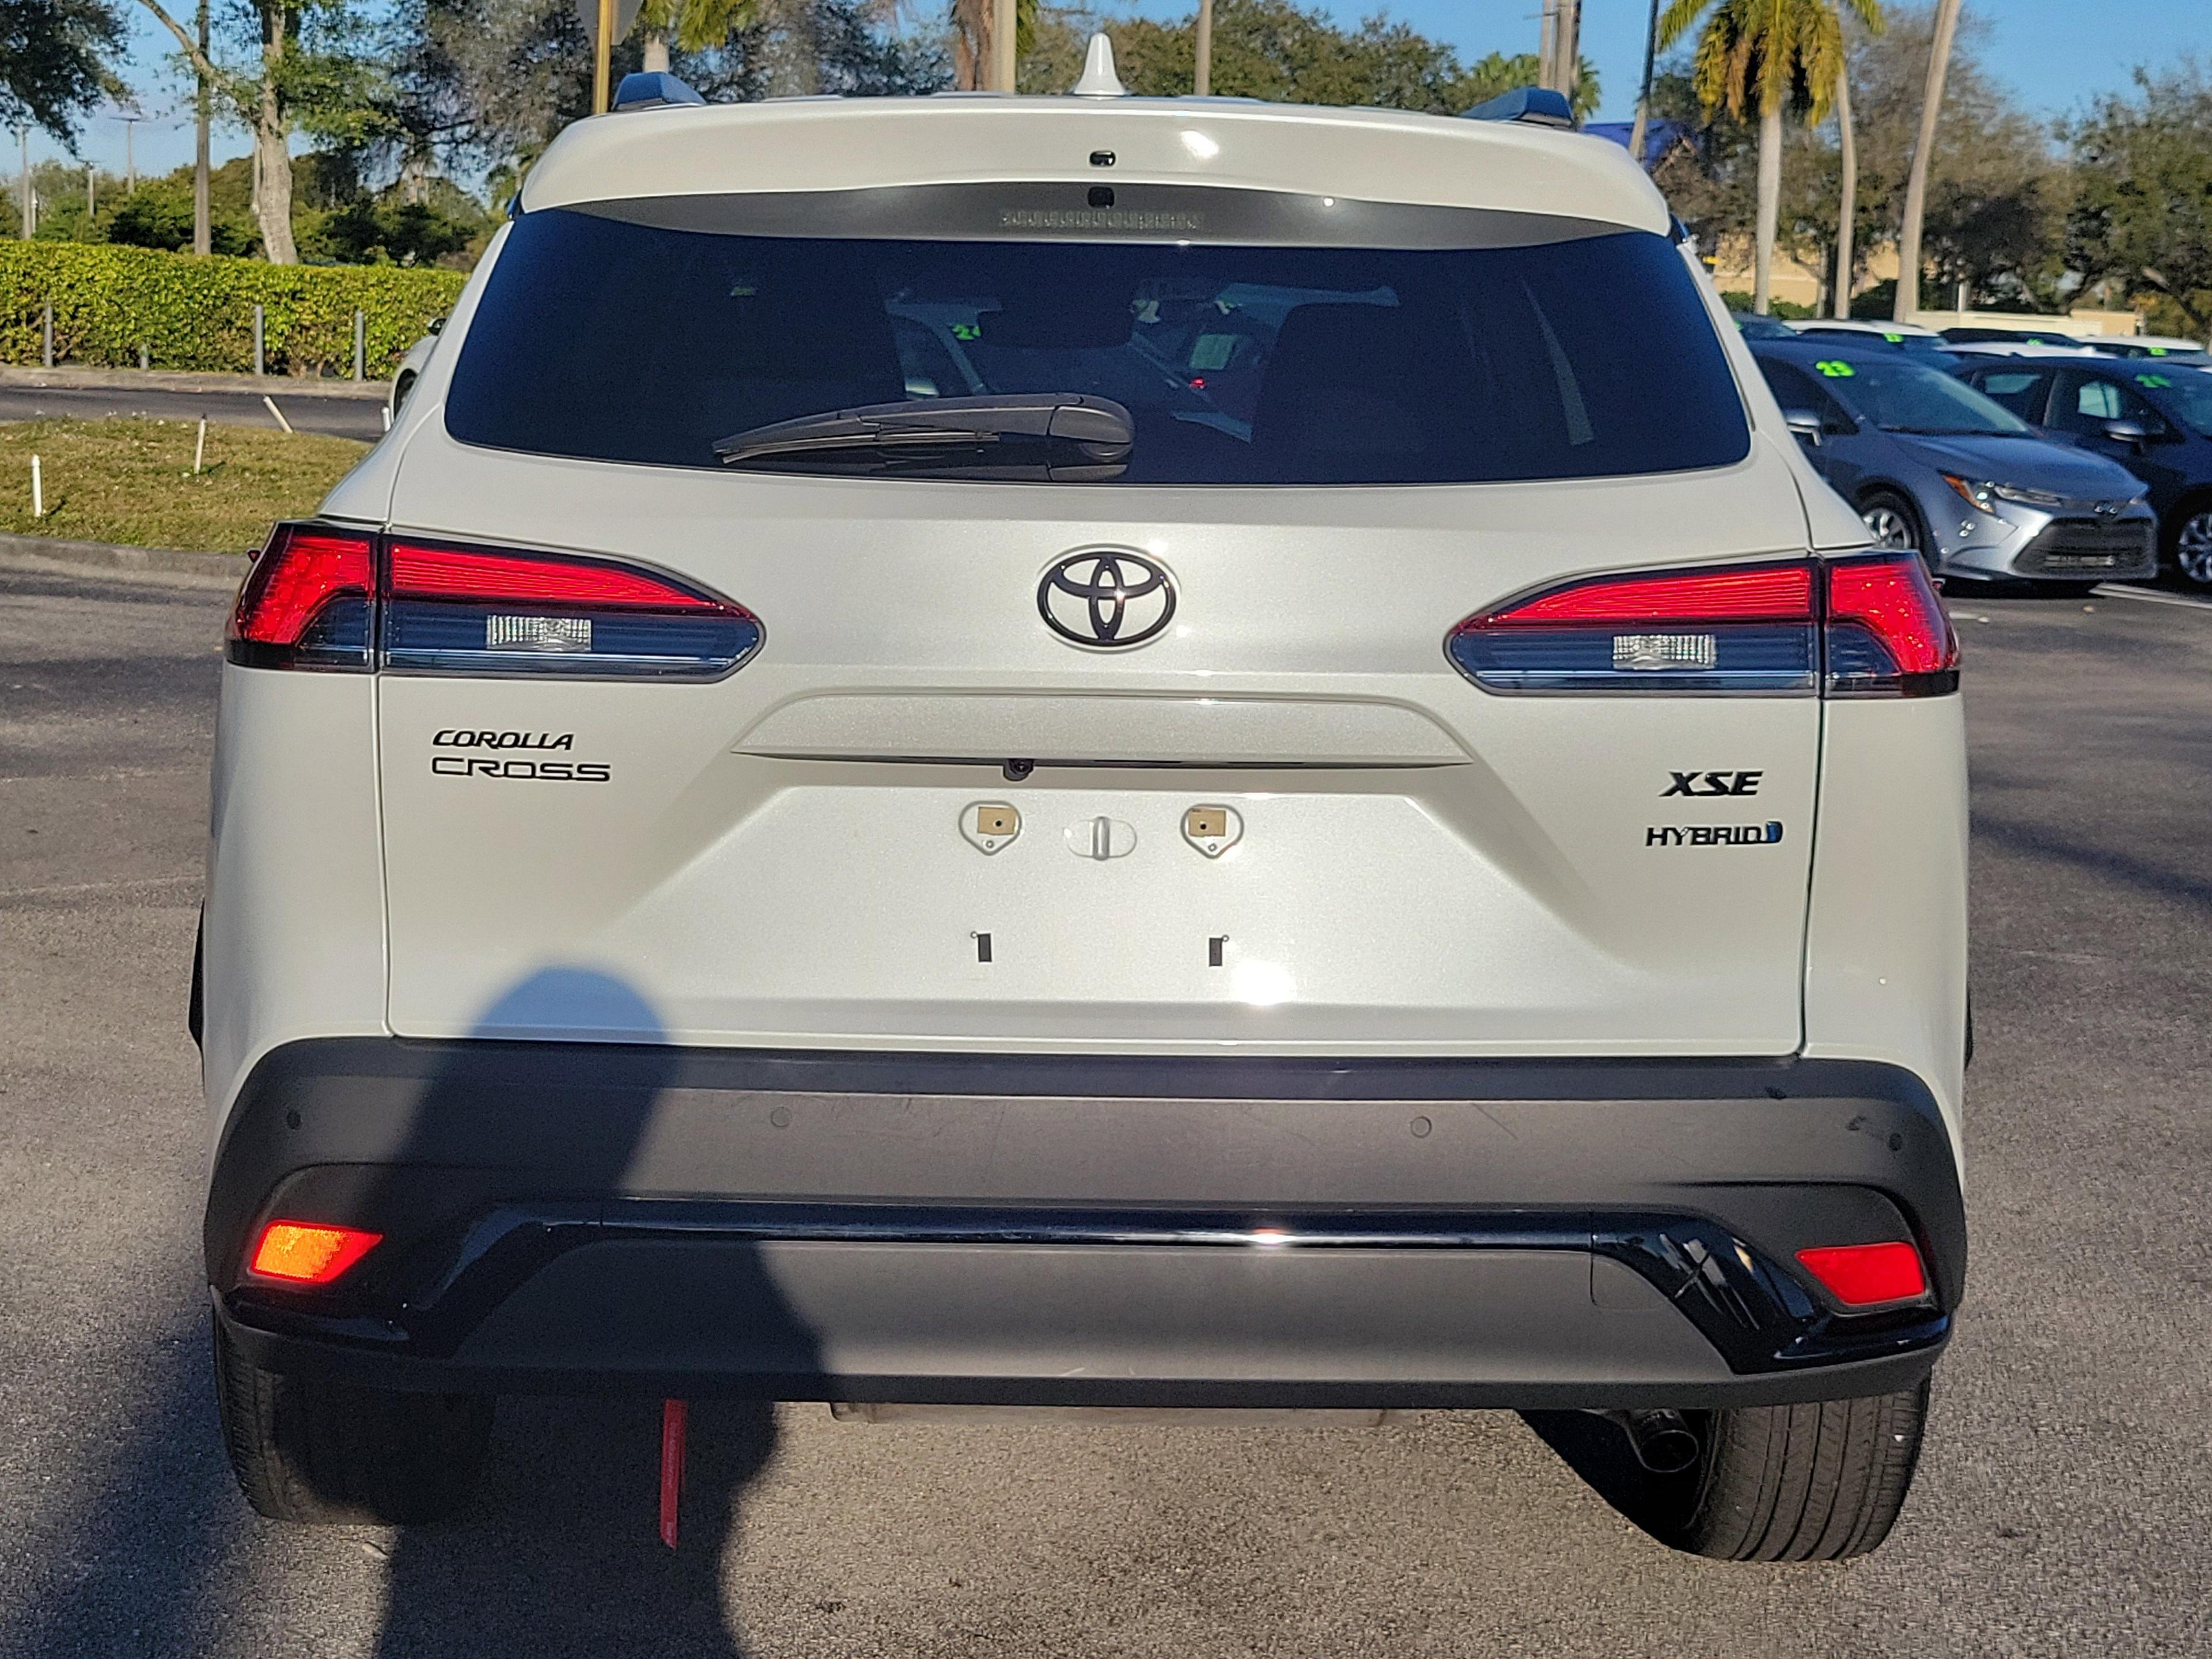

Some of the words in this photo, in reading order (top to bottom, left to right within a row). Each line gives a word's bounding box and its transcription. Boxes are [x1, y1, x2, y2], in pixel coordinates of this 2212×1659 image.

[433, 730, 574, 750] COROLLA
[432, 757, 611, 782] CROSS
[1658, 771, 1764, 796] XSE
[1646, 826, 1762, 846] HYBRID
